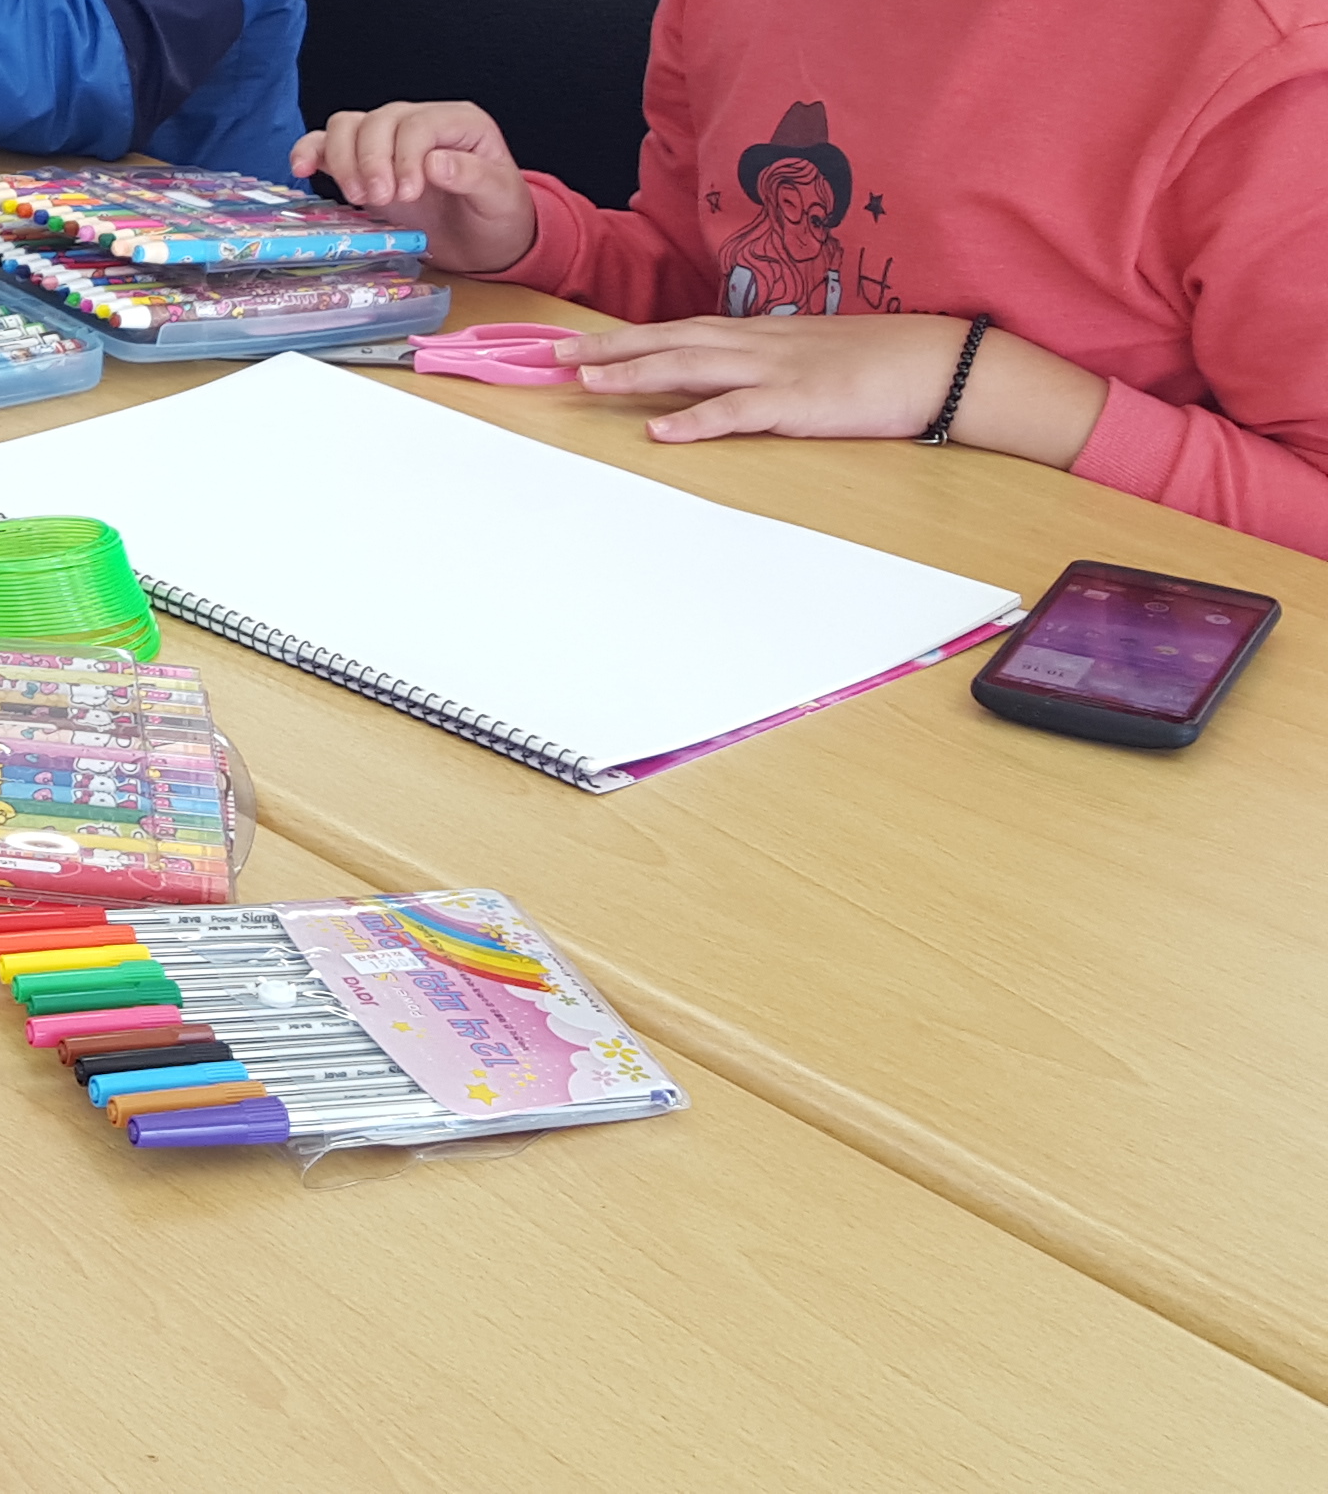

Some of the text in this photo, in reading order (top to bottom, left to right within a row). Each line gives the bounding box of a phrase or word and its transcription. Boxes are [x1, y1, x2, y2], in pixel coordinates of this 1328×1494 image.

[210, 914, 240, 923] Power
[355, 910, 472, 1013] 파워인펜
[342, 975, 381, 1008] Java
[393, 985, 426, 1019] Power
[448, 1017, 520, 1068] 12색
